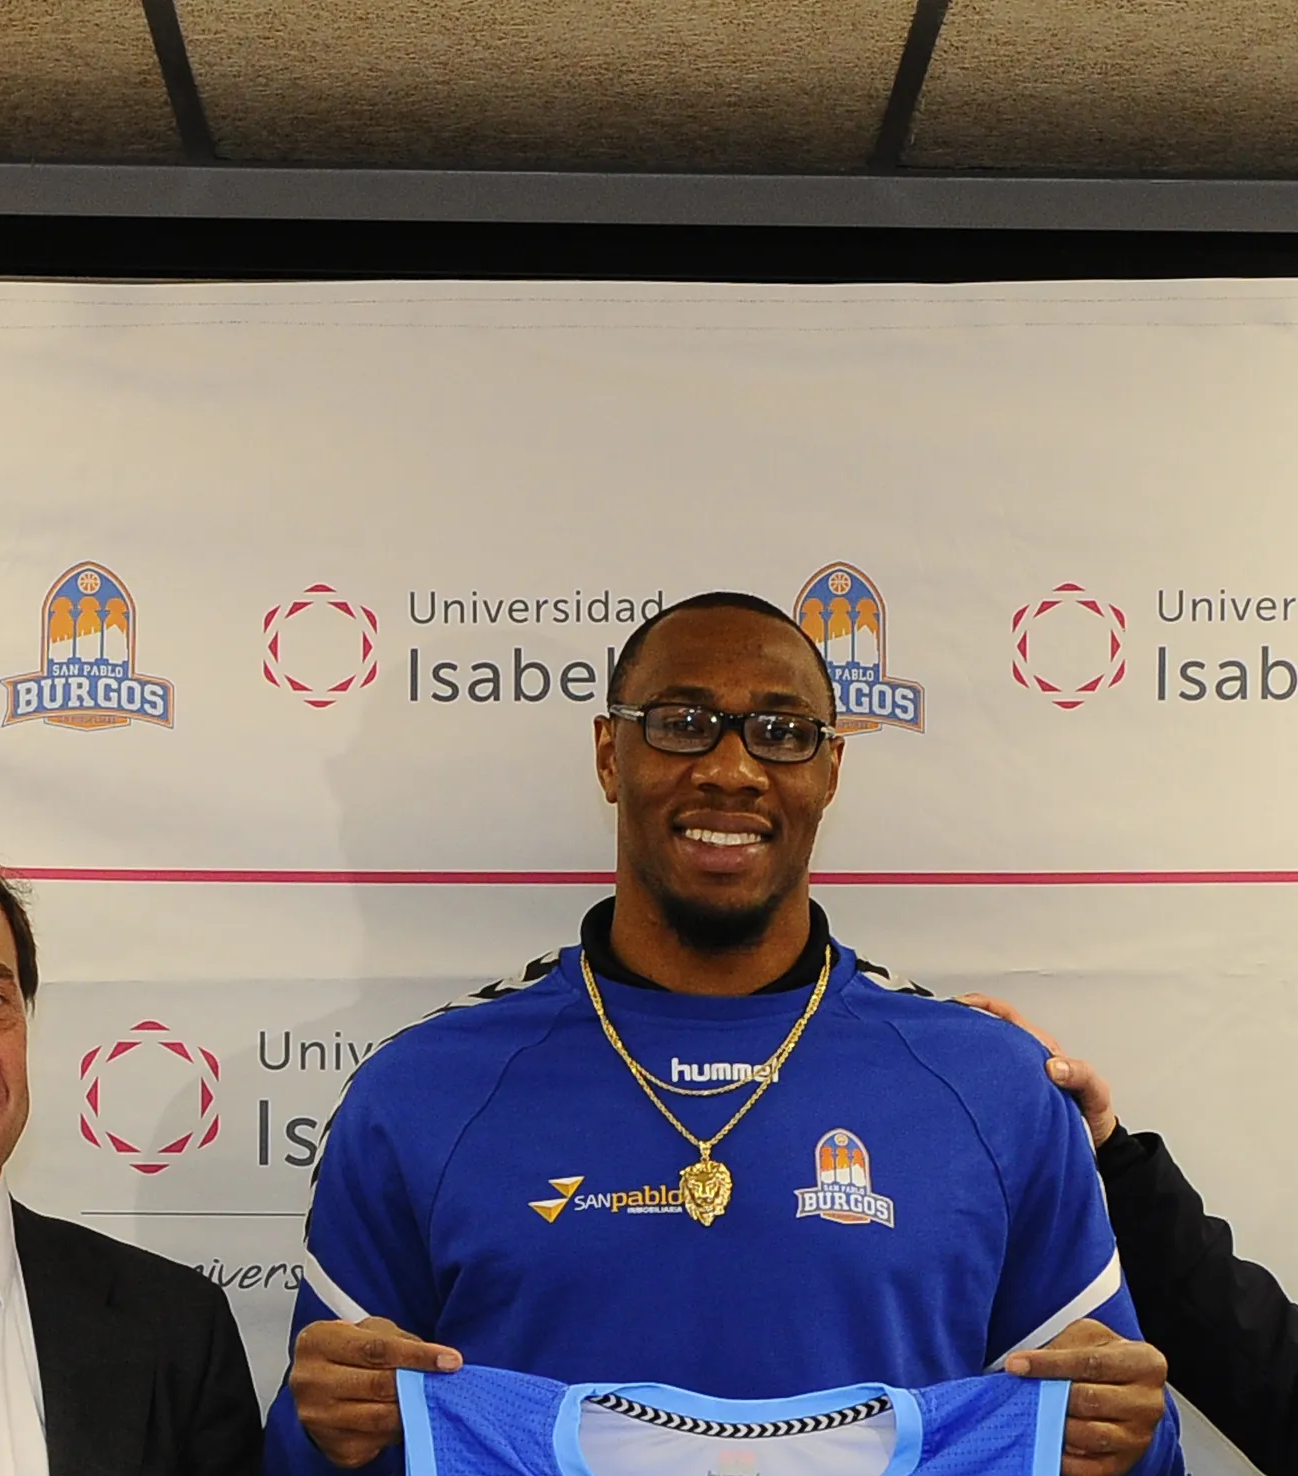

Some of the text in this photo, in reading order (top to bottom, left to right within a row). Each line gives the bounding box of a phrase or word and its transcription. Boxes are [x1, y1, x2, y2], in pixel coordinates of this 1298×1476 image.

[409, 590, 664, 625] Universidad
[53, 664, 123, 678] SAN PABLO
[835, 668, 875, 681] PABLO
[16, 676, 164, 716] BURGOS
[804, 1191, 889, 1220] BURGOS
